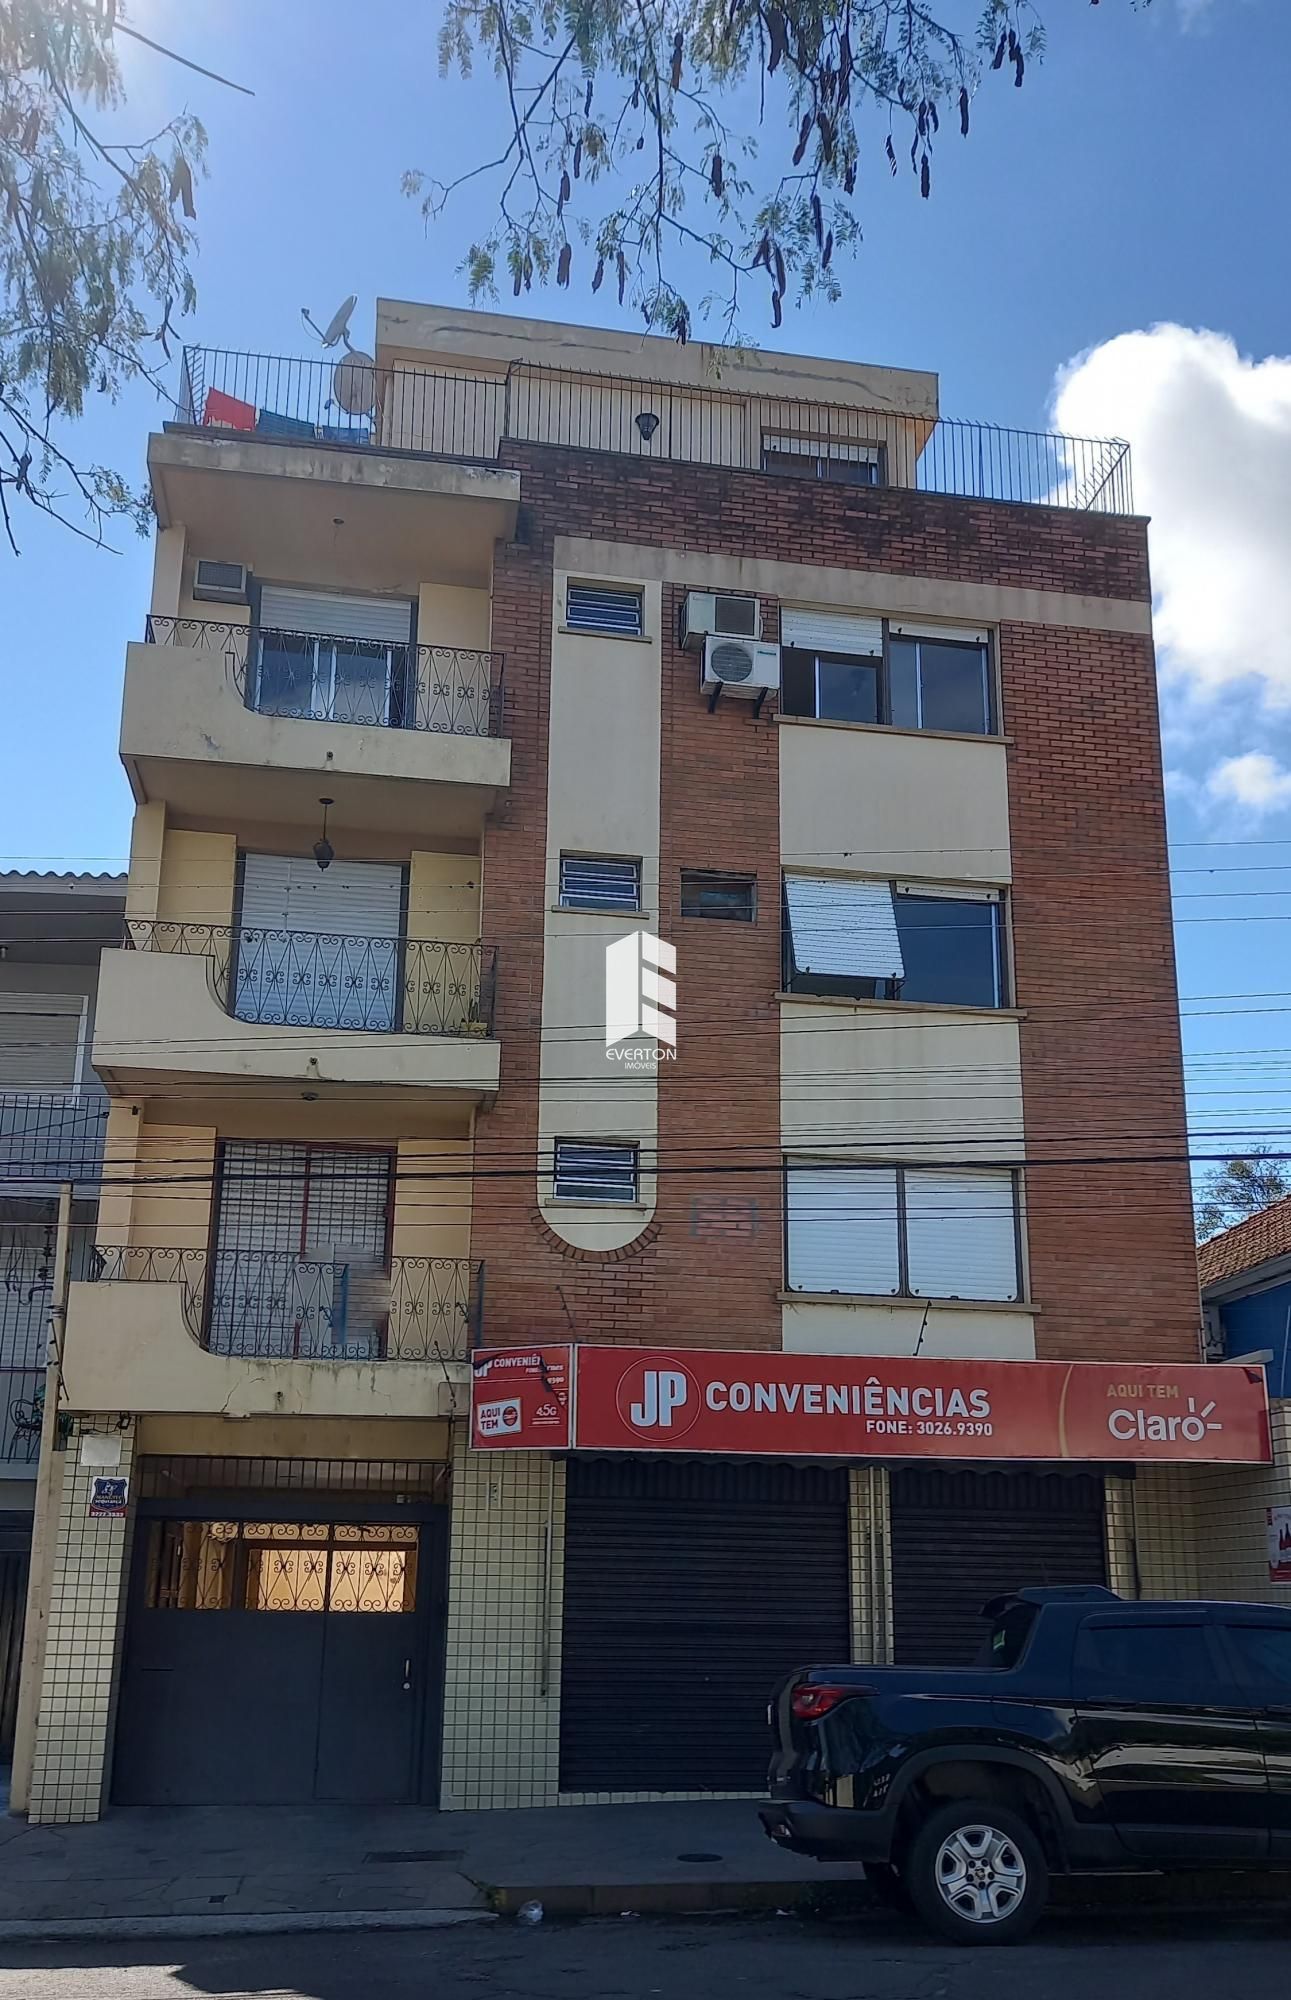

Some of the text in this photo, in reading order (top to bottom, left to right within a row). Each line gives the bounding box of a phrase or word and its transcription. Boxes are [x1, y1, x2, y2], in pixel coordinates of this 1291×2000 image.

[630, 1370, 991, 1427] JP CONVENIÊNCIAS
[1107, 1384, 1179, 1399] AQUI TEM
[480, 1407, 501, 1420] AQUI
[480, 1419, 499, 1430] TEM
[866, 1419, 993, 1437] FONE: 3026.9390
[1107, 1407, 1206, 1442] Claro
